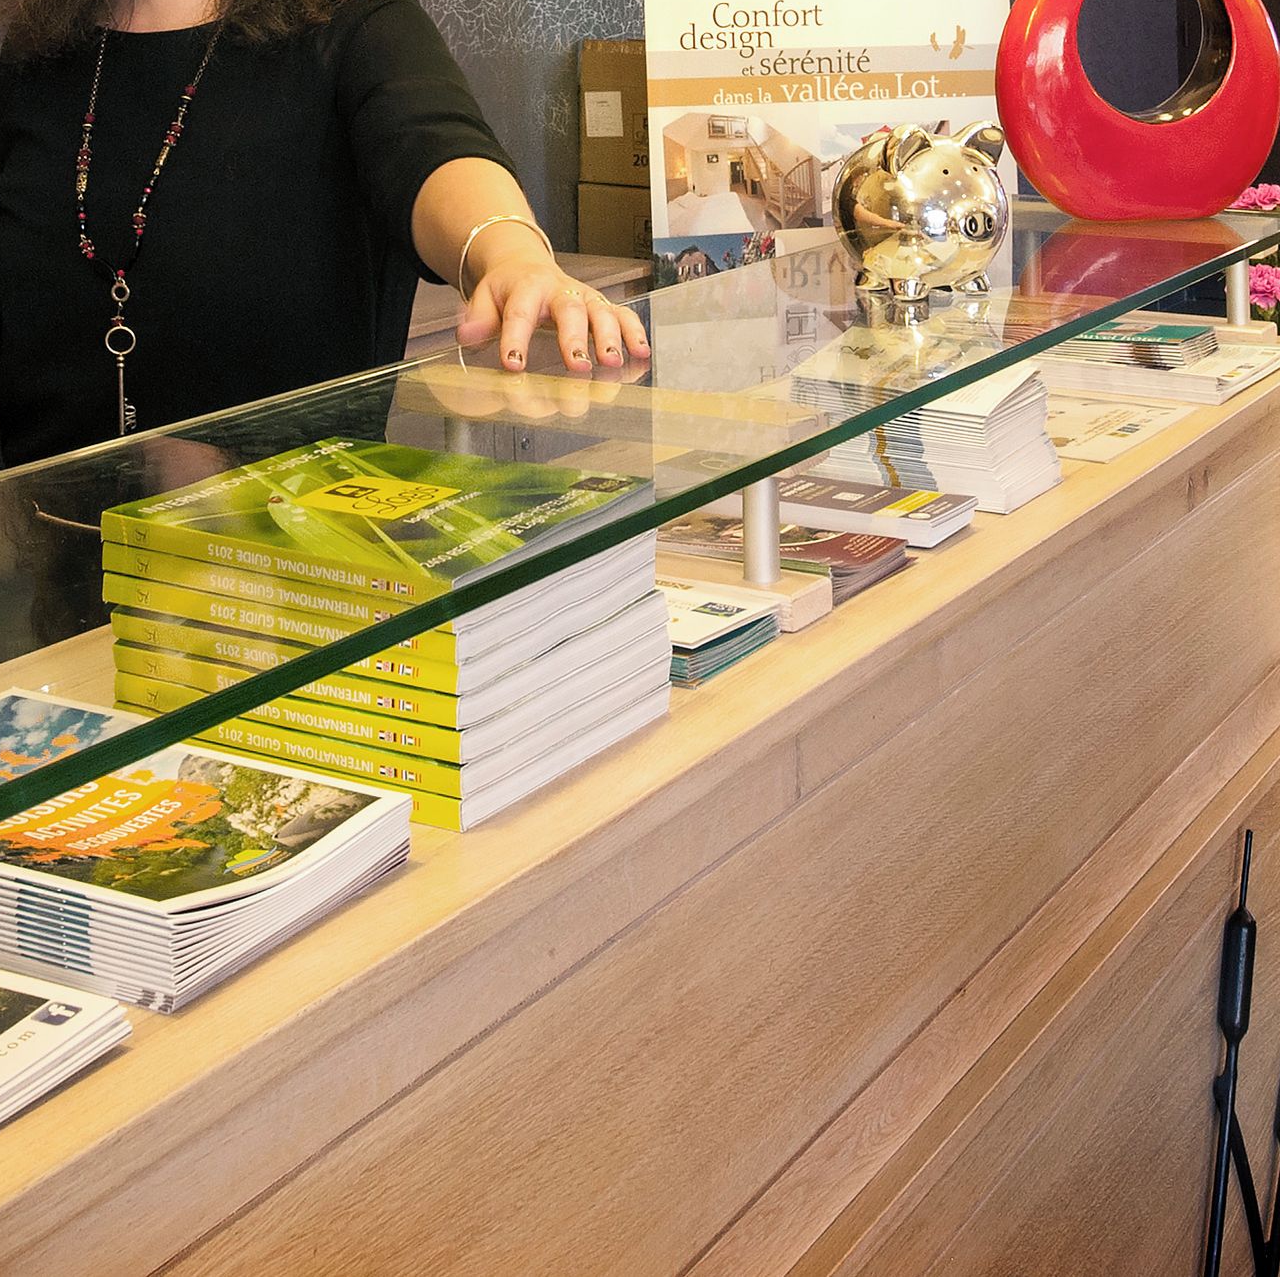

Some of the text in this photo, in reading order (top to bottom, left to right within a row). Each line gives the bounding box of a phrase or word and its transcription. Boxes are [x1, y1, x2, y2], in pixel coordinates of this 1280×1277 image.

[712, 0, 824, 29] Confort
[679, 23, 774, 59] design
[741, 48, 872, 77] et sérénité
[713, 73, 968, 106] dans la vallée du Lot...
[138, 469, 264, 514] INTERNATIONAL
[207, 543, 367, 588] INTERNATIONAL GUIDE 2015
[209, 574, 369, 620] INTERNATIONAL GUIDE 2015
[209, 603, 236, 620] 2015
[239, 611, 275, 630] GUIDE
[215, 642, 241, 657] 2015
[283, 709, 374, 739] INTERNATIONAL
[218, 726, 375, 774] INTERNATIONAL GUIDE 2015
